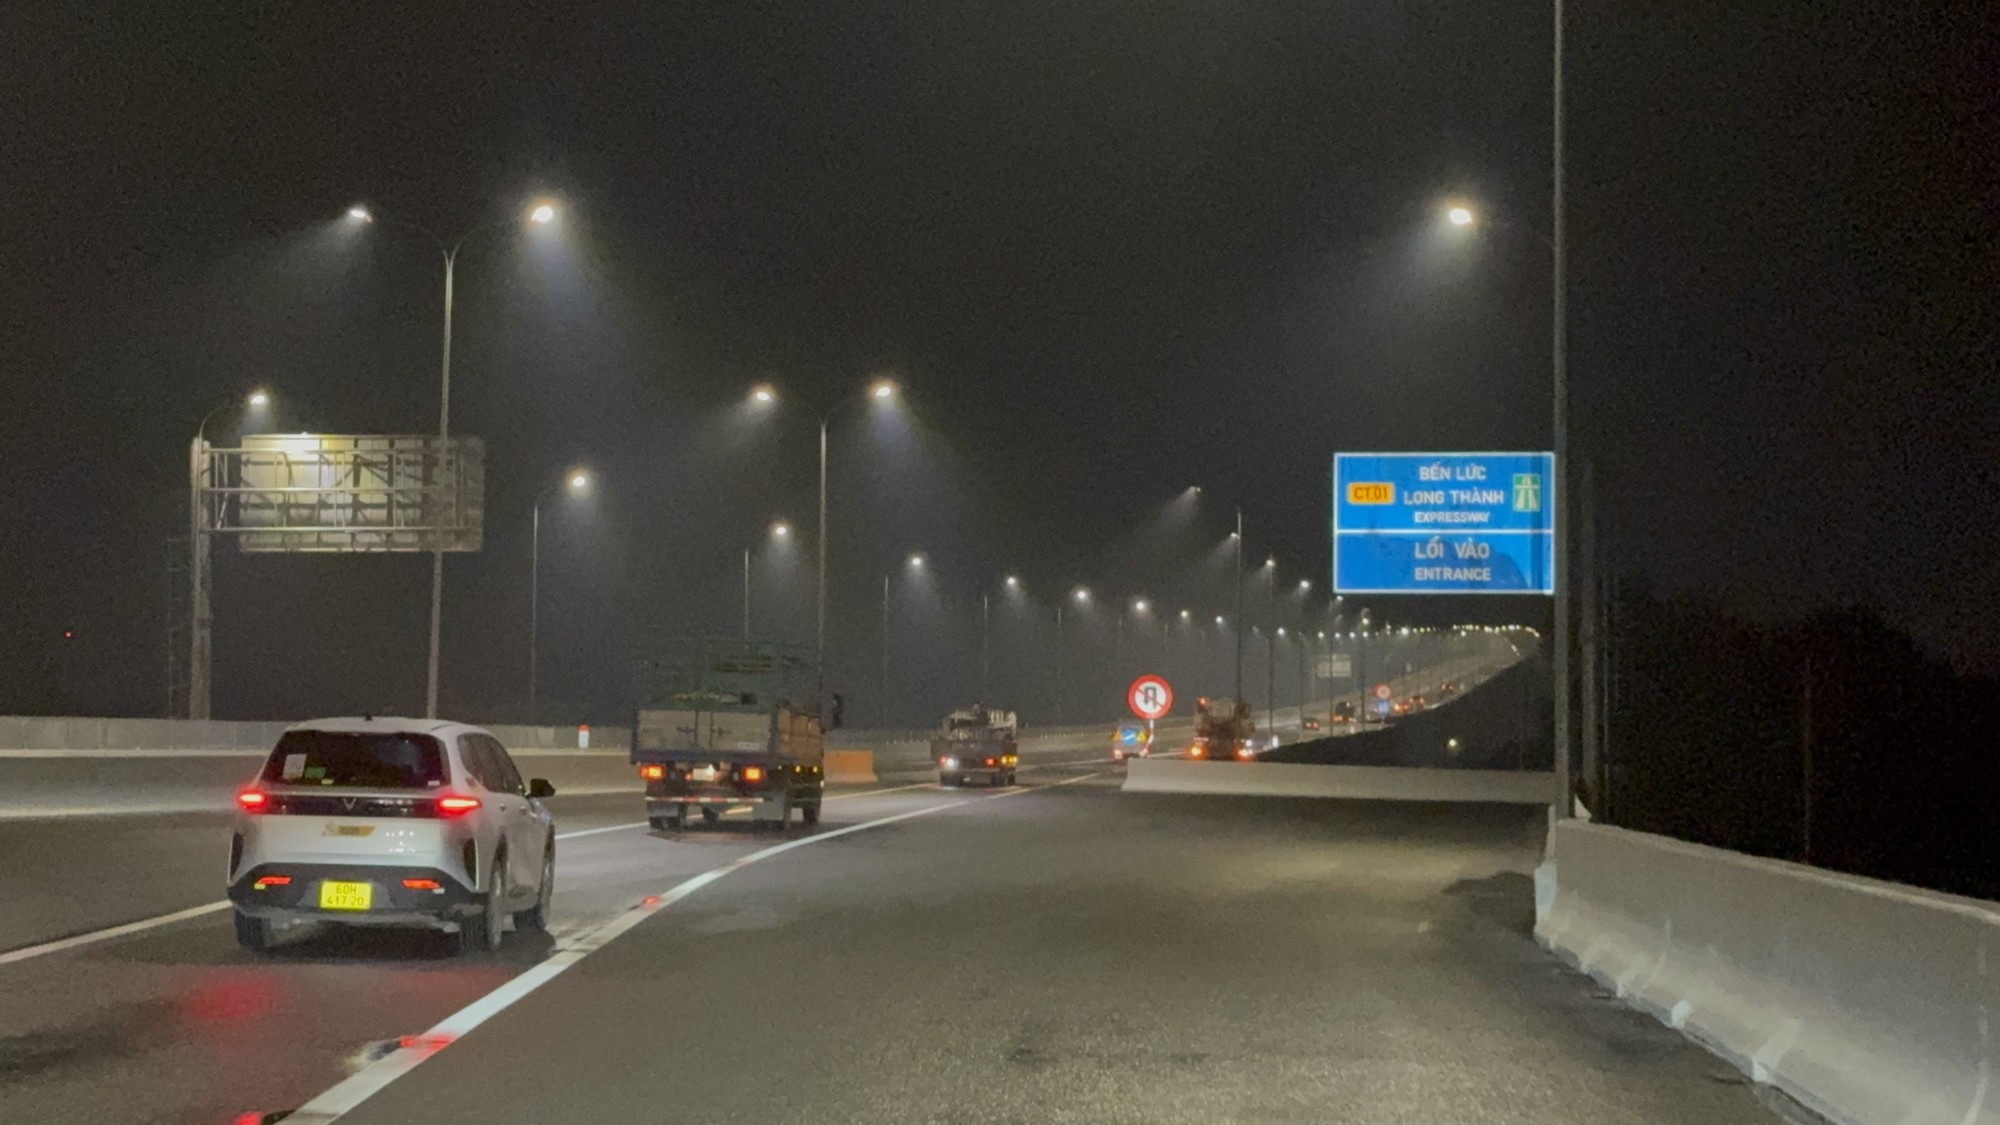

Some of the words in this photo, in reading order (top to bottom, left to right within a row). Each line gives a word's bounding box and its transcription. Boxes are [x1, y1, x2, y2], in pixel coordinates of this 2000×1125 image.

[1419, 461, 1451, 481] BẾN
[1456, 463, 1487, 481] LỨC
[1354, 486, 1388, 500] CT.01
[1404, 490, 1444, 505] LONG
[1450, 486, 1504, 505] THÀNH
[1414, 511, 1490, 523] EXPRESSWAY
[1414, 536, 1444, 559] LỐI
[1454, 537, 1490, 559] VÀO
[1415, 567, 1491, 581] ENTRANCE
